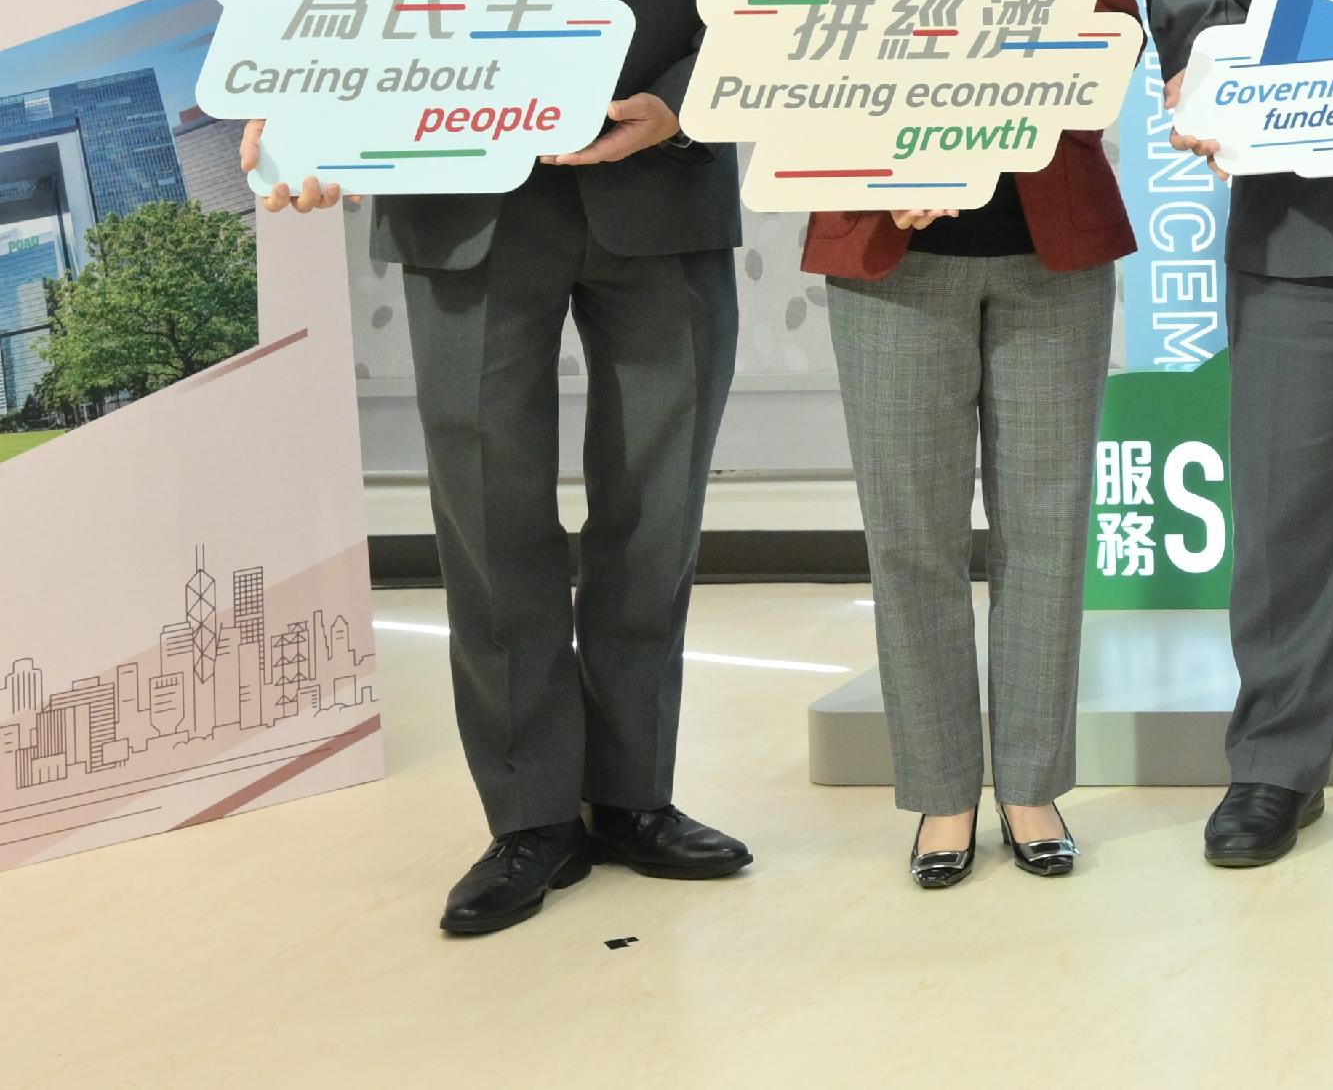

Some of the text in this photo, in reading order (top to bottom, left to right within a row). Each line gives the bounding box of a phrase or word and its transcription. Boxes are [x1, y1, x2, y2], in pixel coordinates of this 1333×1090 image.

[224, 59, 501, 102] Caring about
[711, 73, 1099, 117] Pursuing economic
[414, 99, 562, 141] people
[892, 117, 1039, 160] growth
[1095, 440, 1156, 577] 服務
